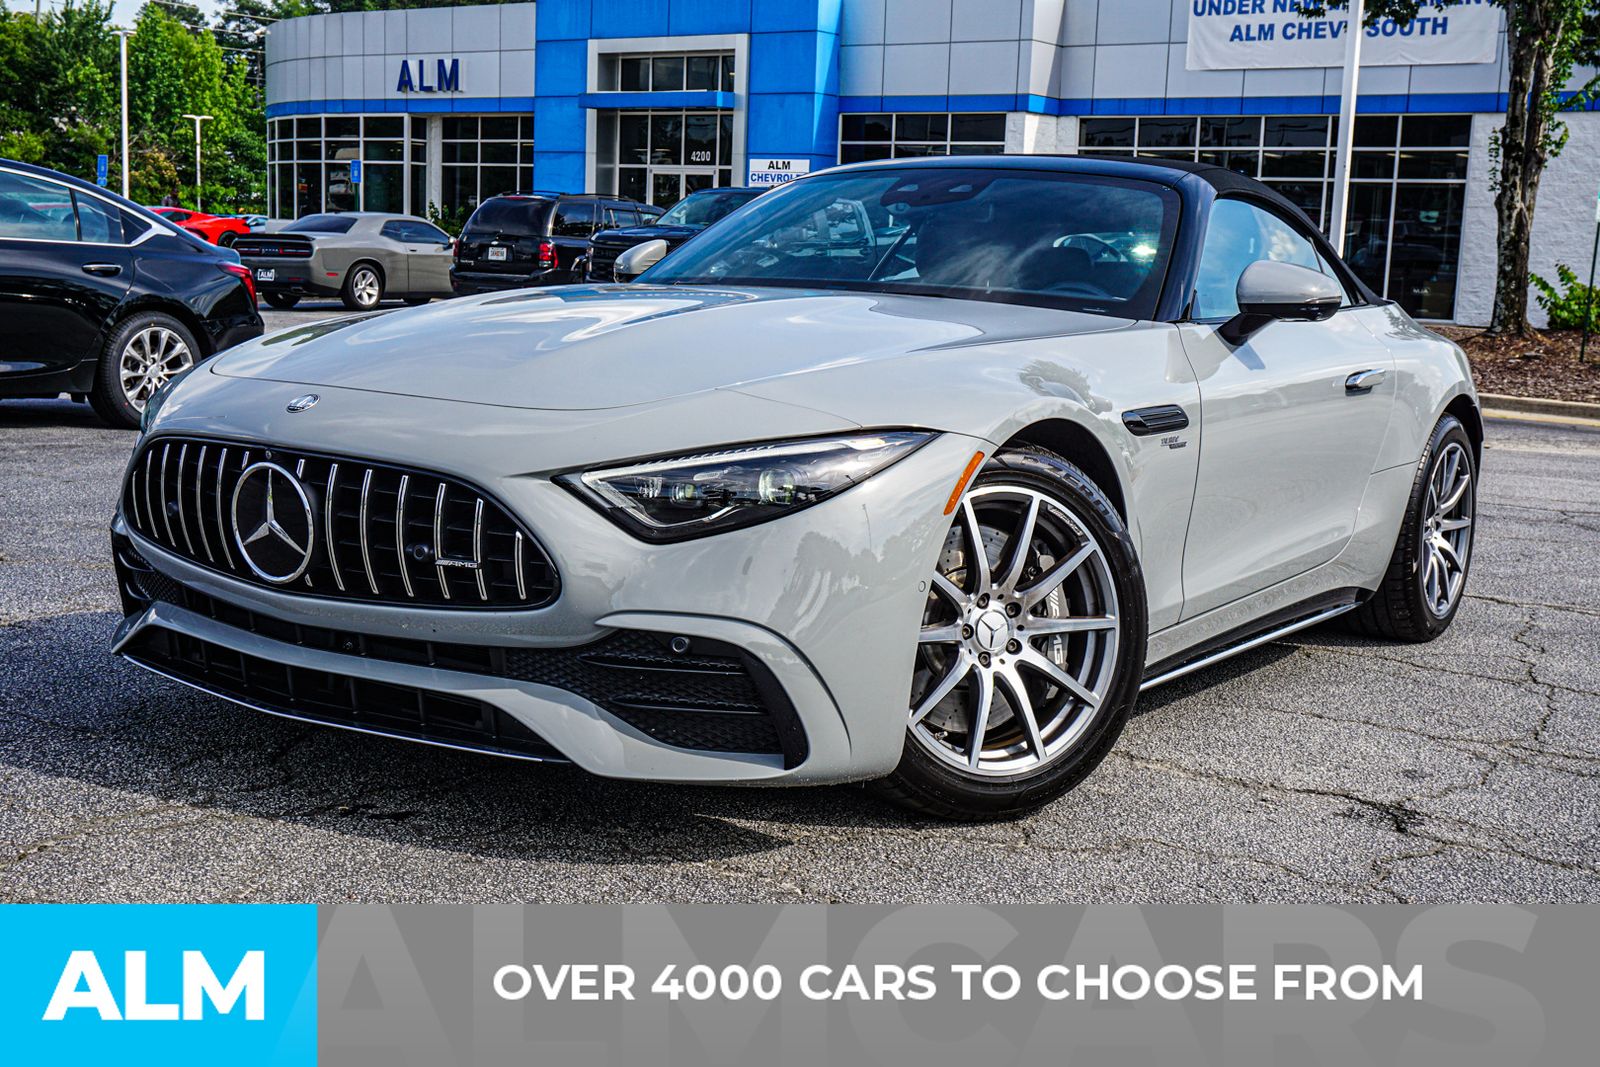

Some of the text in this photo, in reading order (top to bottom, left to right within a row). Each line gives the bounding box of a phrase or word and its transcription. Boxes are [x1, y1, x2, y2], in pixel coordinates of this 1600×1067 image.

[1193, 0, 1265, 17] UNDER
[1229, 16, 1448, 42] ALM CHEV SOUTH
[397, 58, 460, 92] ALM
[691, 151, 711, 162] 4200
[767, 160, 791, 170] ALM
